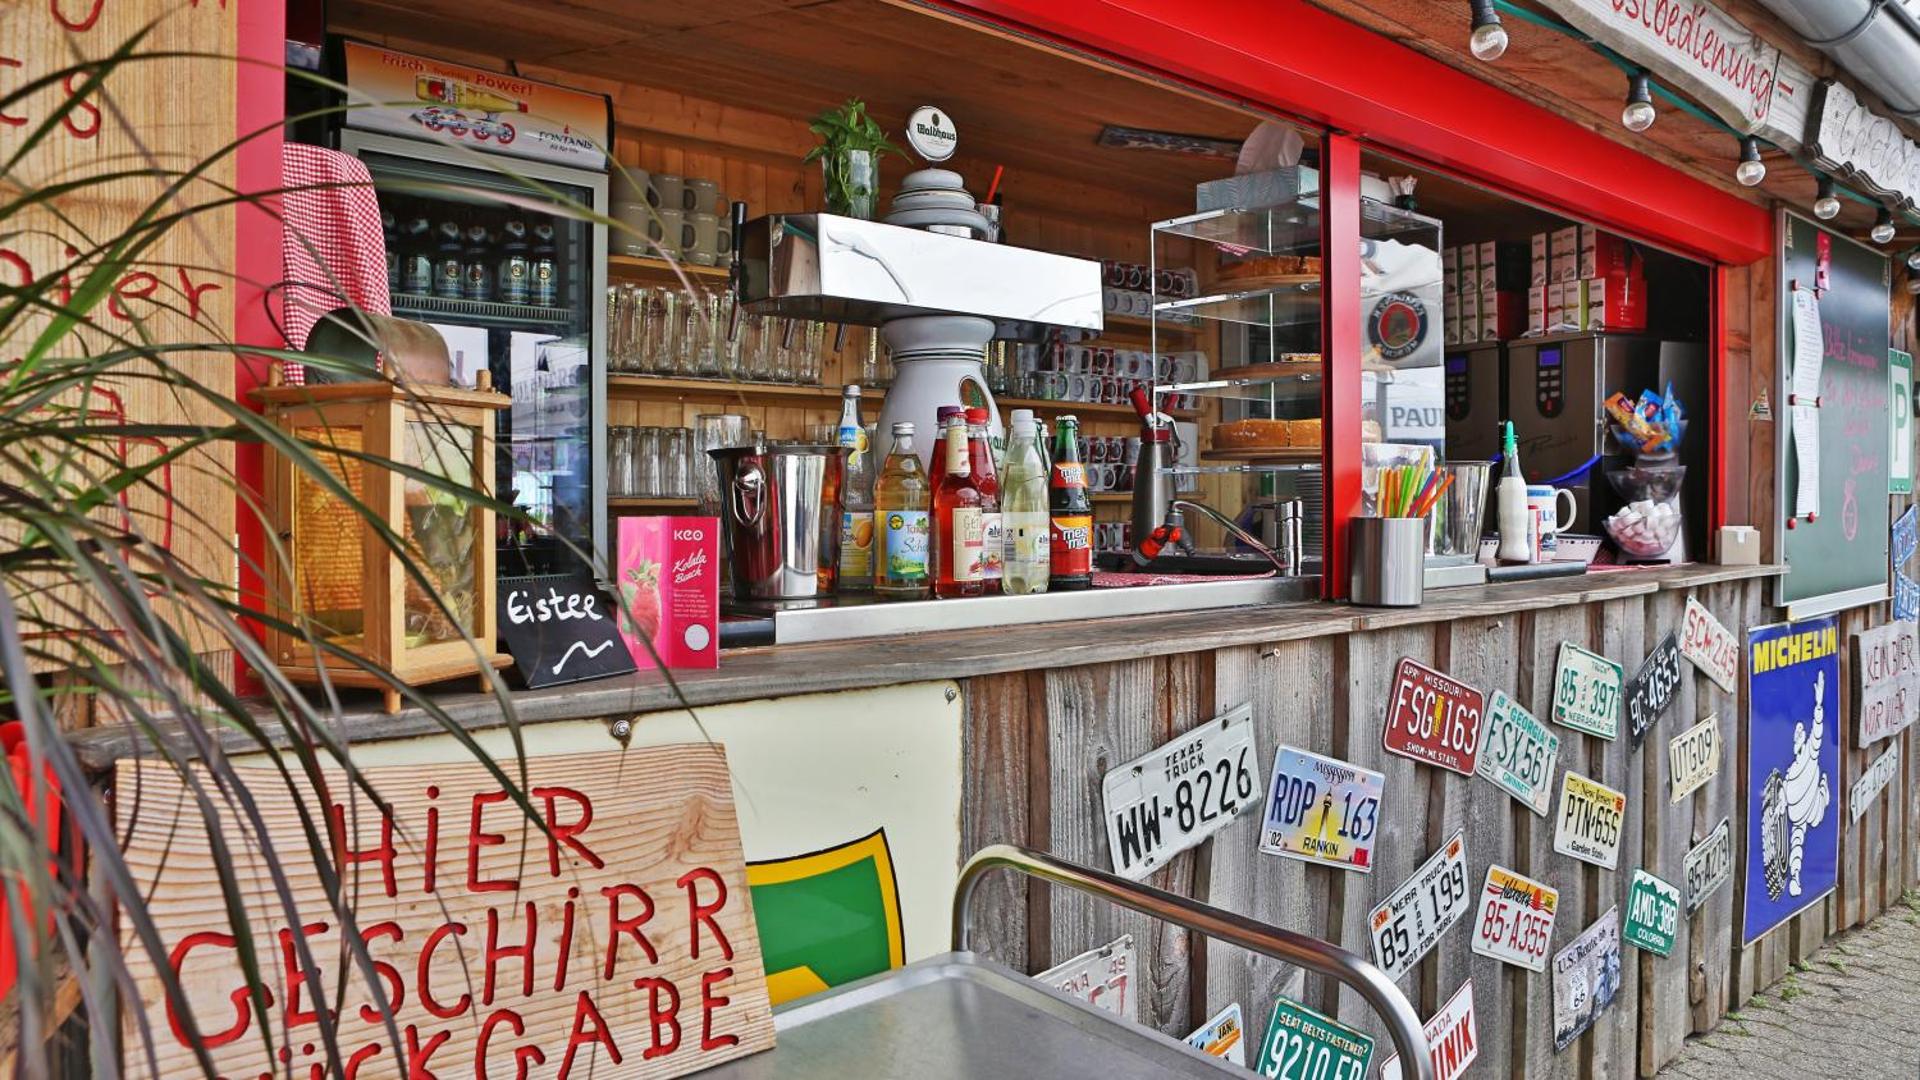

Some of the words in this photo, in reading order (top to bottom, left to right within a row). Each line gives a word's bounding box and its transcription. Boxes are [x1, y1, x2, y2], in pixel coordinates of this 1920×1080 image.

[382, 53, 425, 72] Frisch
[475, 74, 532, 97] Power!
[507, 587, 604, 624] Eistee
[1753, 626, 1838, 675] MICHELIN
[1424, 674, 1463, 698] MISSOURI
[1561, 668, 1578, 706] 85
[1591, 679, 1616, 719] 397
[1392, 679, 1436, 740] FSG
[1441, 699, 1480, 755] 163
[1510, 706, 1546, 746] GEORGIA
[1164, 738, 1204, 768] TEXAS
[1164, 751, 1206, 783] TRUCK
[1484, 711, 1524, 773] FSX
[1521, 737, 1551, 793] 561
[1270, 772, 1317, 828] RDP
[1338, 790, 1378, 842] 163
[334, 785, 604, 898] HIER
[1302, 836, 1340, 857] RANKIN
[1391, 887, 1418, 916] NEBR
[1420, 856, 1448, 889] TRUCK
[1380, 913, 1410, 971] 85
[1428, 860, 1466, 925] 199
[164, 867, 736, 1050] GESCHIRR
[1279, 1011, 1302, 1031] SEAT
[1301, 1021, 1325, 1042] BELTS
